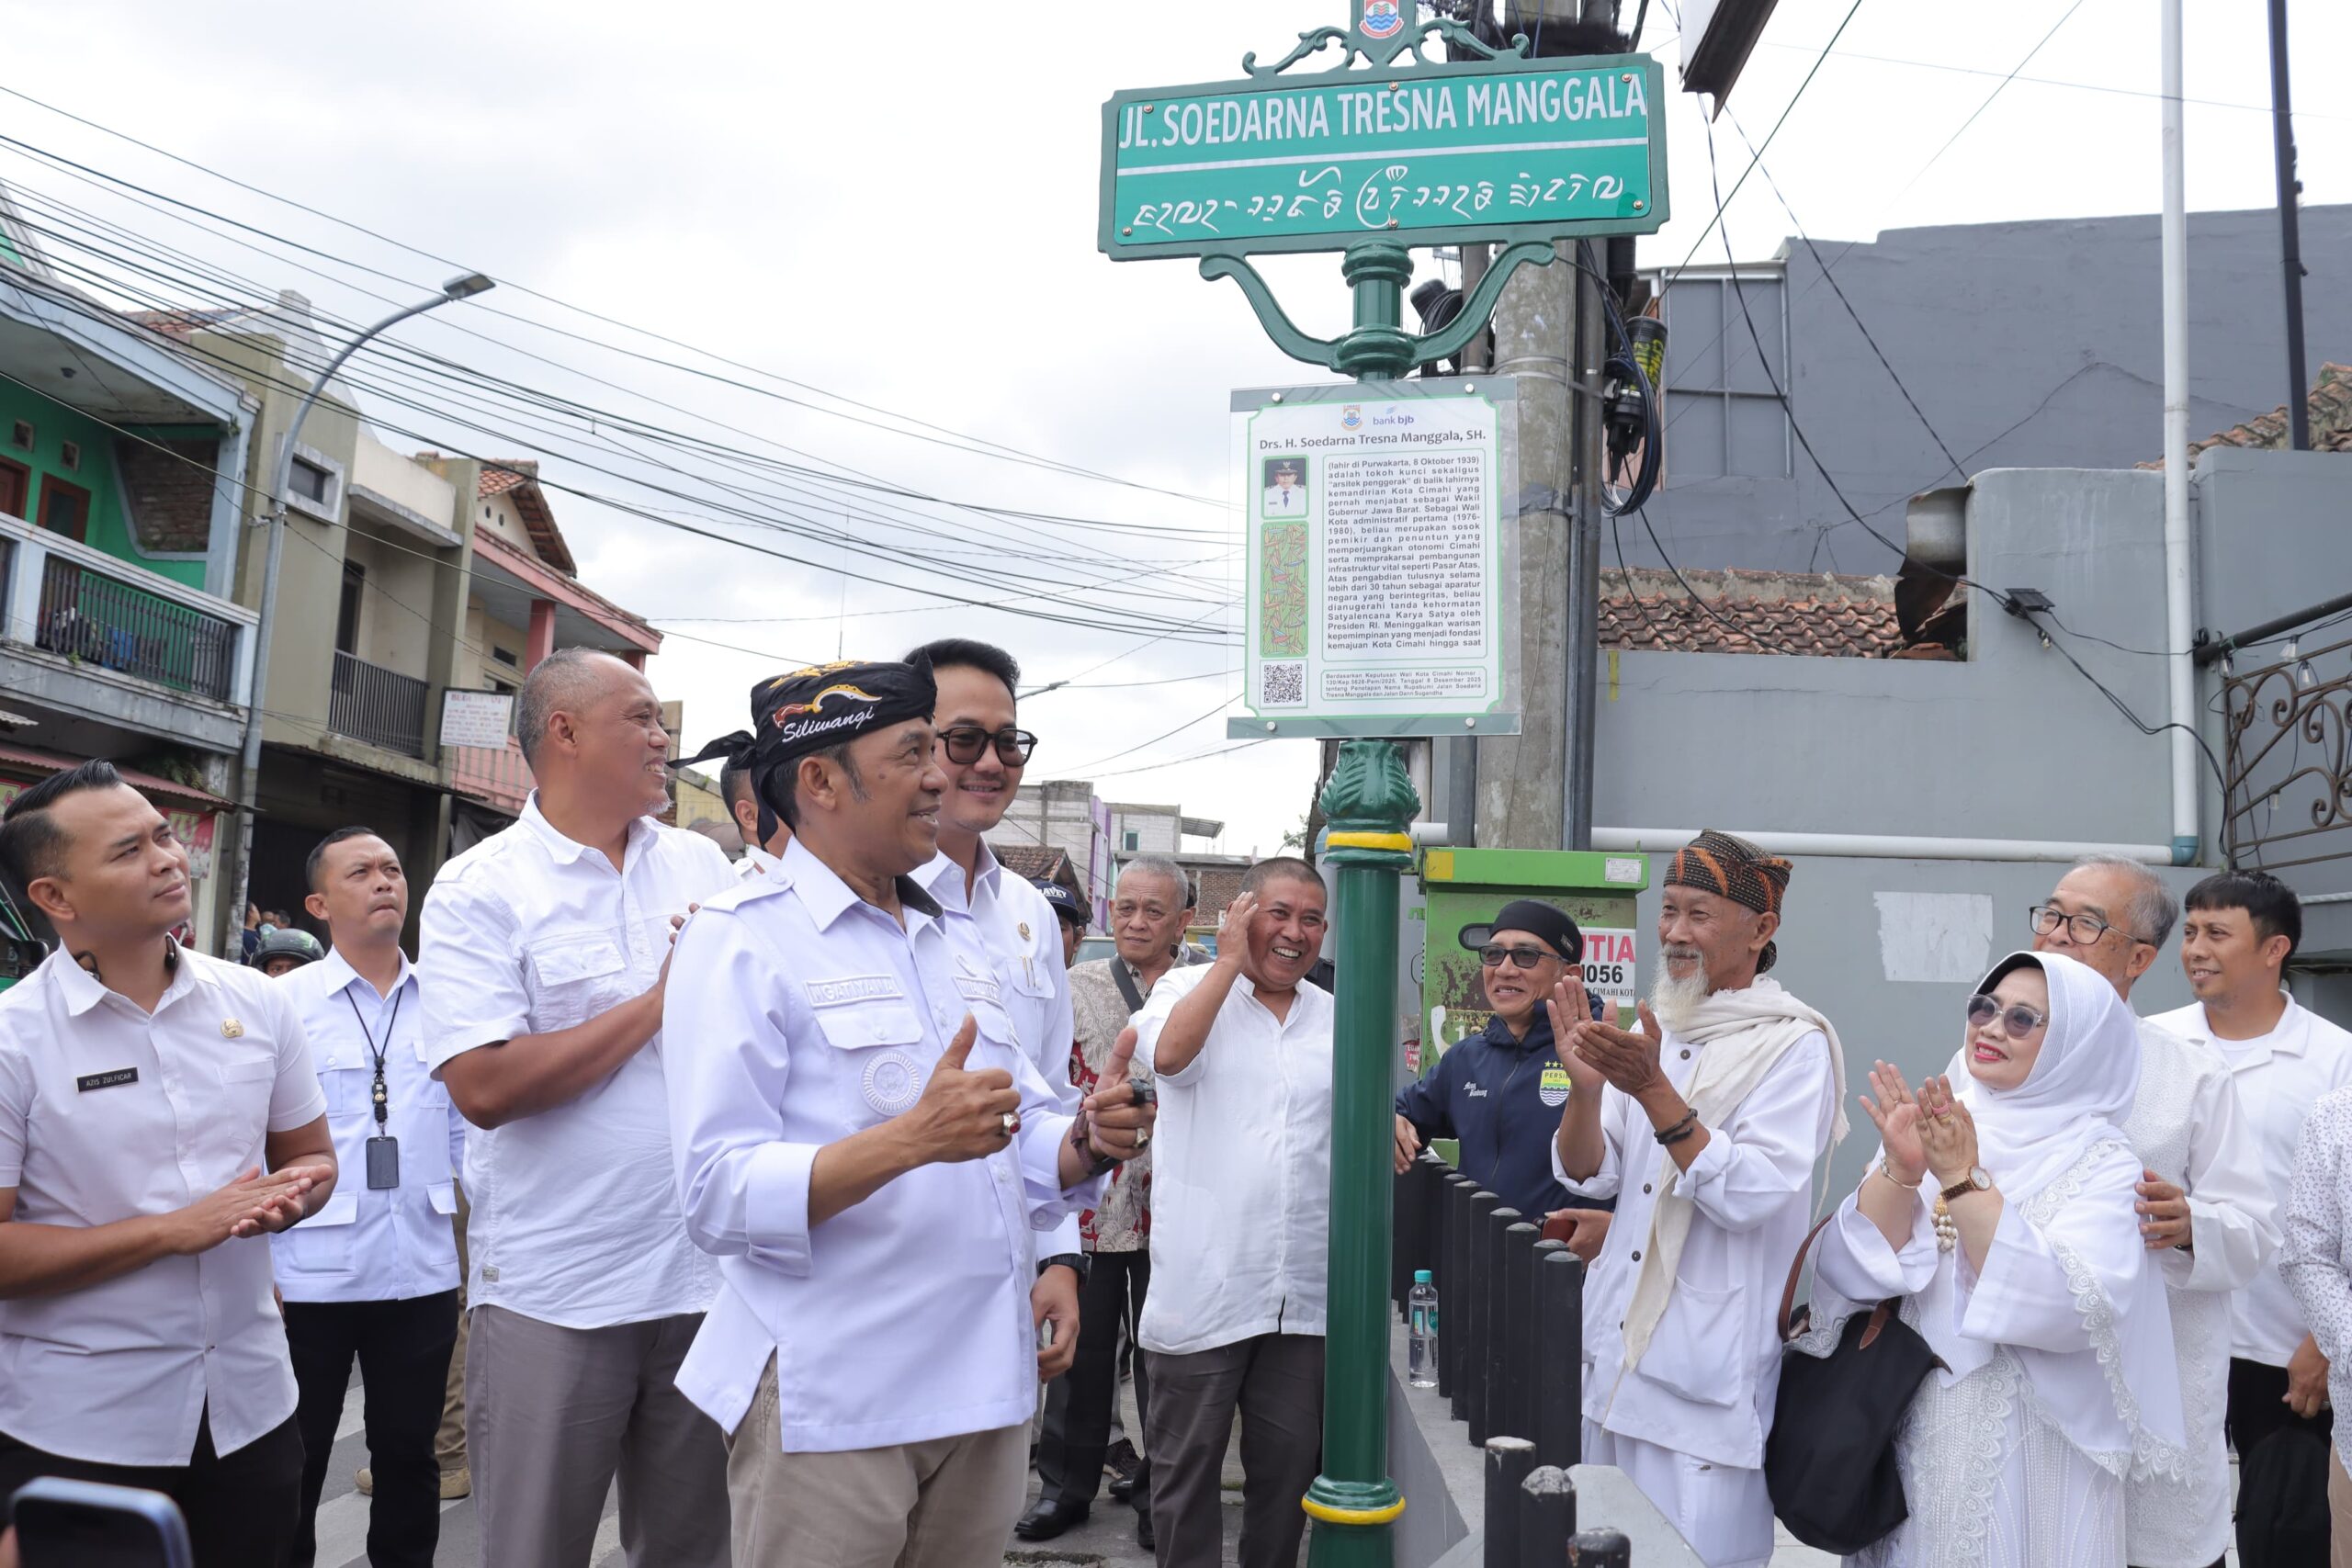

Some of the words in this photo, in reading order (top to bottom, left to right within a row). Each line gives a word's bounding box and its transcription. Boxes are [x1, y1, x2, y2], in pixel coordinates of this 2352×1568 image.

[1337, 86, 1457, 135] TRESNA
[1466, 73, 1647, 127] MANGGALA
[1373, 415, 1396, 425] bank
[1397, 415, 1414, 426] bjb
[1260, 439, 1283, 450] Drs.
[1285, 438, 1297, 448] H.
[1300, 435, 1356, 447] Soedarna
[1358, 434, 1397, 445] Tresna
[1401, 430, 1464, 445] Manggala,
[1465, 429, 1487, 440] SH.
[1328, 460, 1349, 471] (lahir
[1362, 458, 1410, 469] Purwakarta,
[1420, 456, 1454, 465] Oktober
[1457, 455, 1479, 465] 1939)
[1328, 469, 1360, 478] adalah
[1366, 468, 1393, 477] tokoh
[1399, 467, 1425, 475] kunci
[1432, 465, 1478, 476] sekaligus
[1423, 475, 1443, 484] balik
[1445, 474, 1479, 485] lahirnya
[1328, 487, 1385, 497] kemandirian
[1391, 486, 1412, 494] Kota
[1418, 485, 1451, 493] Cimahi
[1456, 485, 1479, 494] yang
[1328, 498, 1359, 508] pernah
[1365, 496, 1407, 507] menjabat
[1413, 494, 1448, 505] sebagai
[1454, 493, 1479, 502] Wakil
[1328, 507, 1367, 516] Gubernur
[1371, 506, 1392, 514] Jawa
[1424, 503, 1458, 514] Sebagai
[1461, 503, 1479, 511] Wali
[1328, 517, 1347, 525] Kota
[1353, 515, 1407, 524] administratif
[1412, 513, 1447, 524] pertama
[1453, 512, 1479, 523] (1976-
[1361, 525, 1389, 533] beliau
[1395, 523, 1446, 534] merupakan
[1452, 522, 1479, 530] sosok
[1328, 535, 1367, 546] pemikir
[1373, 534, 1391, 542] dan
[1398, 532, 1448, 543] penuntun
[1454, 533, 1479, 542] yang
[1328, 543, 1402, 555] memperjuangkan
[1408, 542, 1443, 551] otonomi
[1449, 541, 1479, 549] Cimahi
[1328, 555, 1349, 563] serta
[1354, 553, 1413, 564] memprakarsai
[1419, 550, 1479, 562] pembangunan
[1328, 563, 1380, 572] infrastruktur
[1381, 563, 1399, 571] vital
[1401, 562, 1430, 572] seperti
[1432, 561, 1457, 569] Pasar
[1327, 574, 1347, 582] Atas
[1352, 572, 1402, 583] pengabdian
[1407, 571, 1444, 581] tulusnya
[1449, 570, 1480, 578] selama
[1328, 583, 1348, 591] lebih
[1382, 581, 1406, 590] tahun
[1409, 580, 1442, 591] sebagai
[1444, 579, 1480, 590] aparatur
[1328, 594, 1357, 603] negara
[1362, 593, 1384, 602] yang
[1389, 590, 1447, 601] berintegritas,
[1453, 589, 1480, 597] beliau
[1327, 601, 1384, 612] dianugerahi
[1390, 600, 1417, 609] tanda
[1423, 599, 1480, 608] kehormatan
[1328, 611, 1390, 622] Satyalencana
[1396, 610, 1422, 620] Karya
[1428, 609, 1454, 619] Satya
[1460, 608, 1480, 616] oleh
[1328, 621, 1364, 629] Presiden
[1384, 619, 1443, 630] Meninggalkan
[1447, 618, 1480, 626] warisan
[1327, 630, 1389, 641] kepemimpinan
[1391, 631, 1411, 639] yang
[1413, 628, 1446, 639] menjadi
[1448, 628, 1480, 636] fondasi
[1327, 640, 1367, 650] kemajuan
[1372, 639, 1393, 648] Kota
[1396, 639, 1425, 647] Cimahi
[1429, 638, 1458, 648] hingga
[1462, 637, 1480, 645] saat
[782, 705, 875, 743] Siliwangi
[86, 1078, 100, 1087] AZIS
